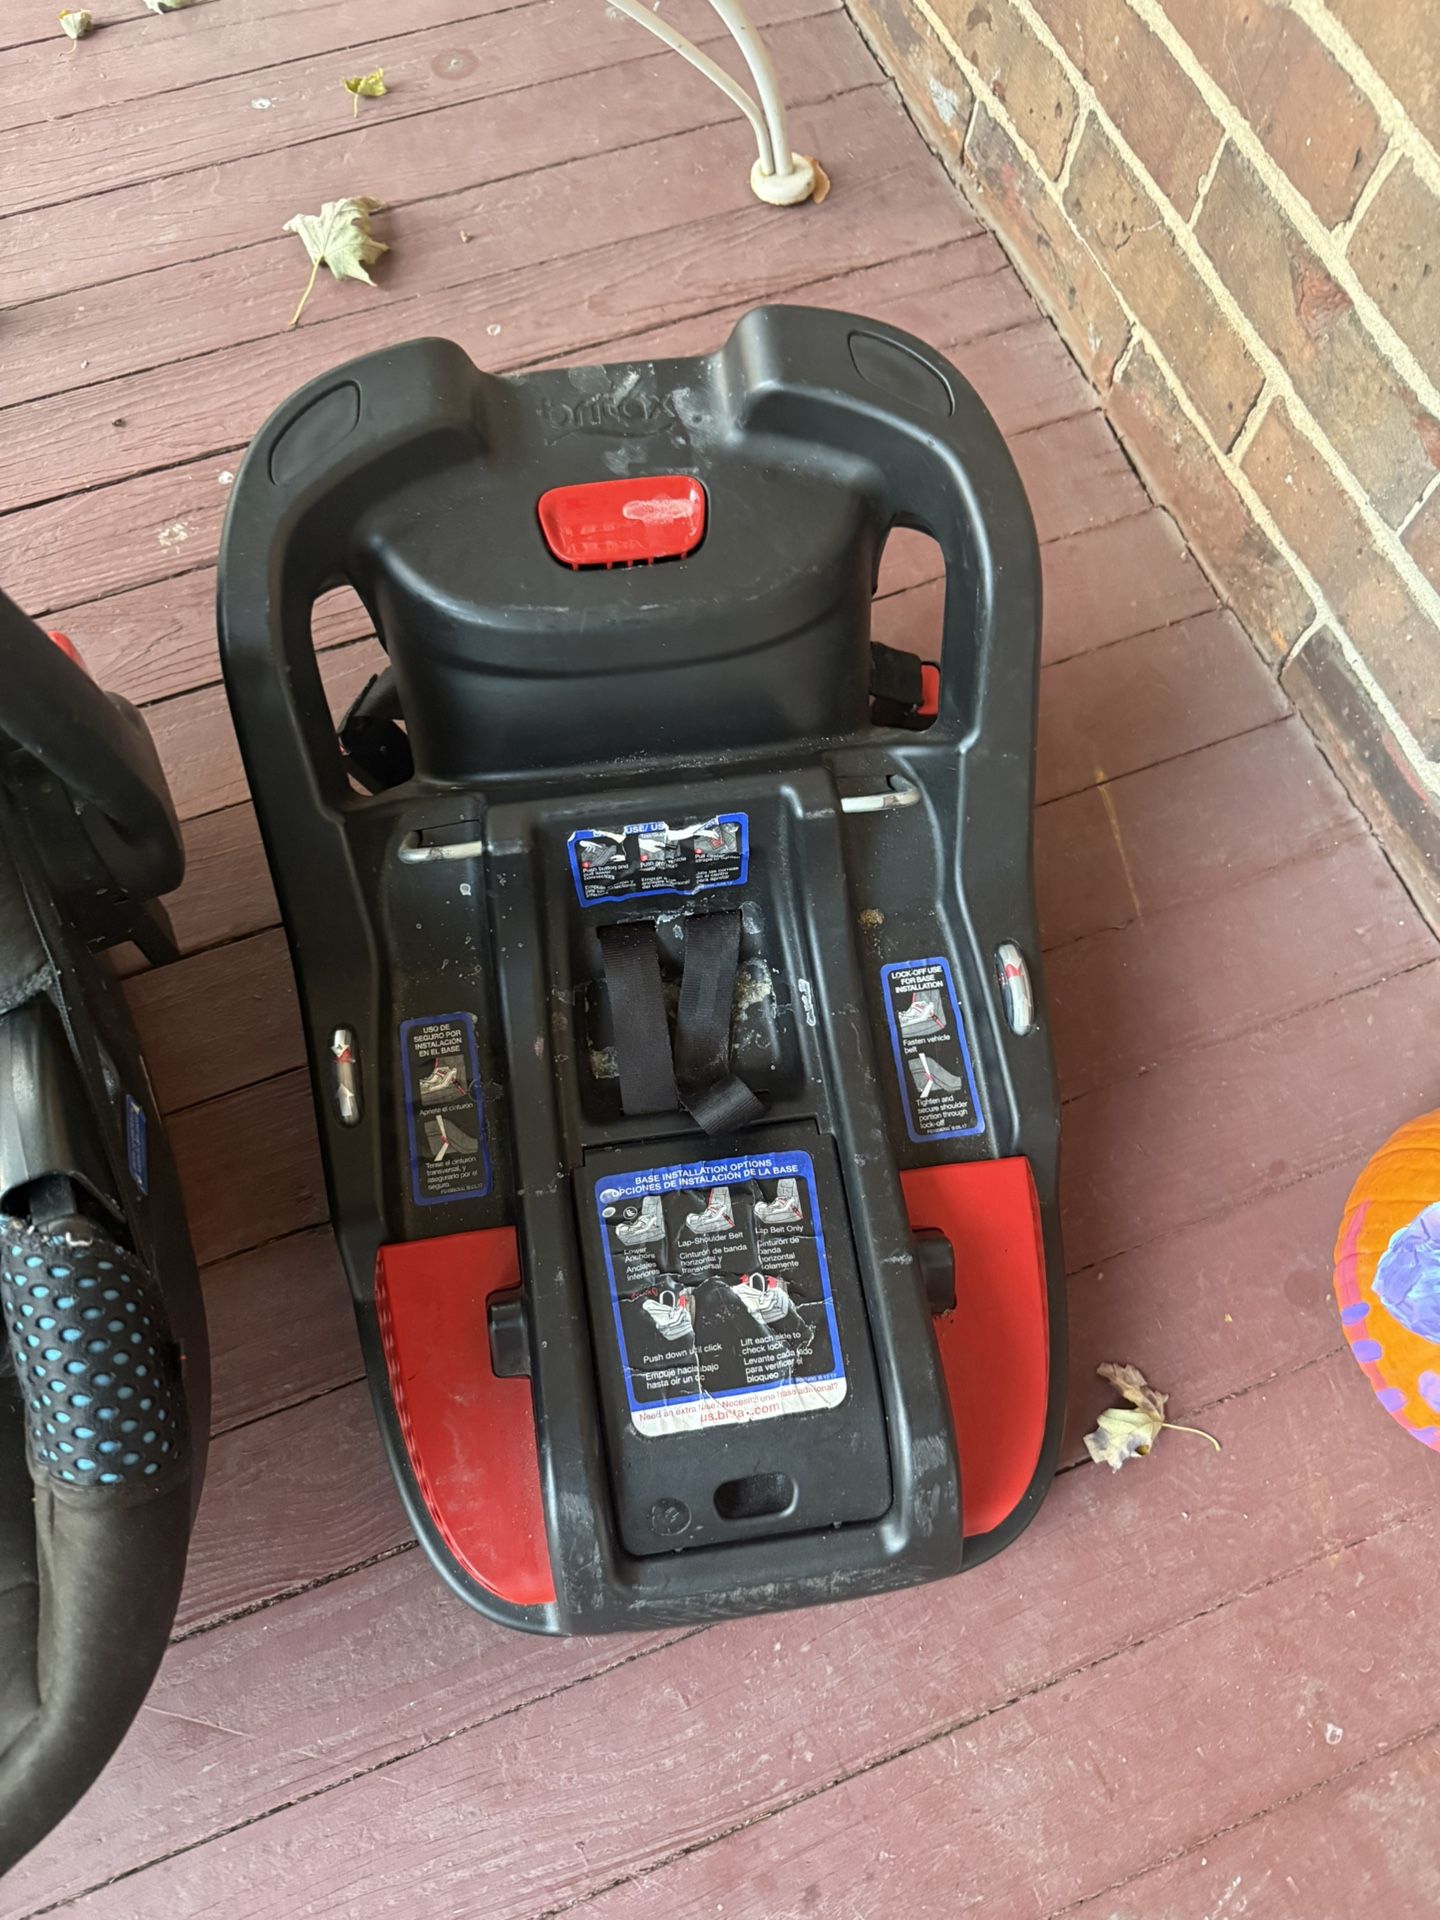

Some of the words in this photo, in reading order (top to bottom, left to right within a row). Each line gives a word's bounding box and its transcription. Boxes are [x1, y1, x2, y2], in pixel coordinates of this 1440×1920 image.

[891, 968, 927, 979] LOCK-OFF
[928, 966, 943, 974] USE
[901, 977, 916, 985] FOR
[916, 974, 935, 983] BASE
[895, 980, 944, 993] INSTALLATION
[423, 1025, 439, 1034] USO
[440, 1023, 450, 1031] DE
[413, 1032, 445, 1043] SEGURO
[445, 1030, 461, 1038] POR
[903, 1037, 927, 1047] Fasten
[927, 1034, 950, 1043] vehicle
[418, 1050, 430, 1058] EN
[430, 1048, 440, 1056] EL
[441, 1045, 461, 1054] BASE
[904, 1046, 918, 1054] belt
[916, 1098, 940, 1107] Tighten
[942, 1095, 954, 1103] and
[918, 1106, 940, 1114] secure
[940, 1101, 968, 1110] shoulder
[919, 1113, 942, 1122] portion
[942, 1109, 968, 1118] through
[920, 1119, 945, 1129] lock-off
[635, 1174, 660, 1186] BASE
[662, 1164, 728, 1182] INSTALLATION
[730, 1159, 772, 1173] OPTIONS
[663, 1179, 676, 1190] DE
[679, 1169, 741, 1186] INSTALACIÓN
[743, 1168, 756, 1178] DE
[758, 1166, 771, 1177] LA
[773, 1163, 799, 1175] BASE
[755, 1226, 769, 1236] Lap
[770, 1226, 785, 1234] Belt
[786, 1224, 803, 1233] Only
[677, 1233, 727, 1248] Lap-Shoulder
[728, 1231, 744, 1240] Belt
[789, 1236, 800, 1244] de
[624, 1246, 647, 1256] Lower
[679, 1248, 711, 1260] Cinturón
[712, 1247, 722, 1255] de
[723, 1243, 748, 1253] banda
[624, 1252, 656, 1264] Anchors
[680, 1255, 717, 1267] horizontal
[718, 1255, 722, 1263] y
[626, 1261, 657, 1274] Anclajes
[681, 1262, 722, 1274] transversal
[763, 1260, 799, 1270] olamente
[627, 1269, 660, 1281] inferiores
[740, 1338, 753, 1347] Lift
[755, 1335, 774, 1344] each
[793, 1331, 801, 1339] to
[643, 1353, 664, 1364] Push
[665, 1349, 688, 1360] down
[704, 1343, 723, 1353] click
[742, 1344, 766, 1355] check
[767, 1341, 784, 1351] lock
[743, 1354, 775, 1366] Levante
[776, 1349, 795, 1360] cada
[797, 1346, 813, 1357] ado
[645, 1369, 676, 1381] Empuje
[677, 1365, 699, 1375] hacia
[700, 1362, 720, 1373] bajo
[745, 1365, 764, 1376] para
[765, 1359, 795, 1371] verificar
[646, 1379, 669, 1391] hasta
[682, 1374, 693, 1384] un
[746, 1372, 779, 1384] bloqueo
[640, 1410, 661, 1421] Need
[663, 1409, 673, 1418] an
[675, 1405, 697, 1416] extra
[760, 1394, 776, 1402] una
